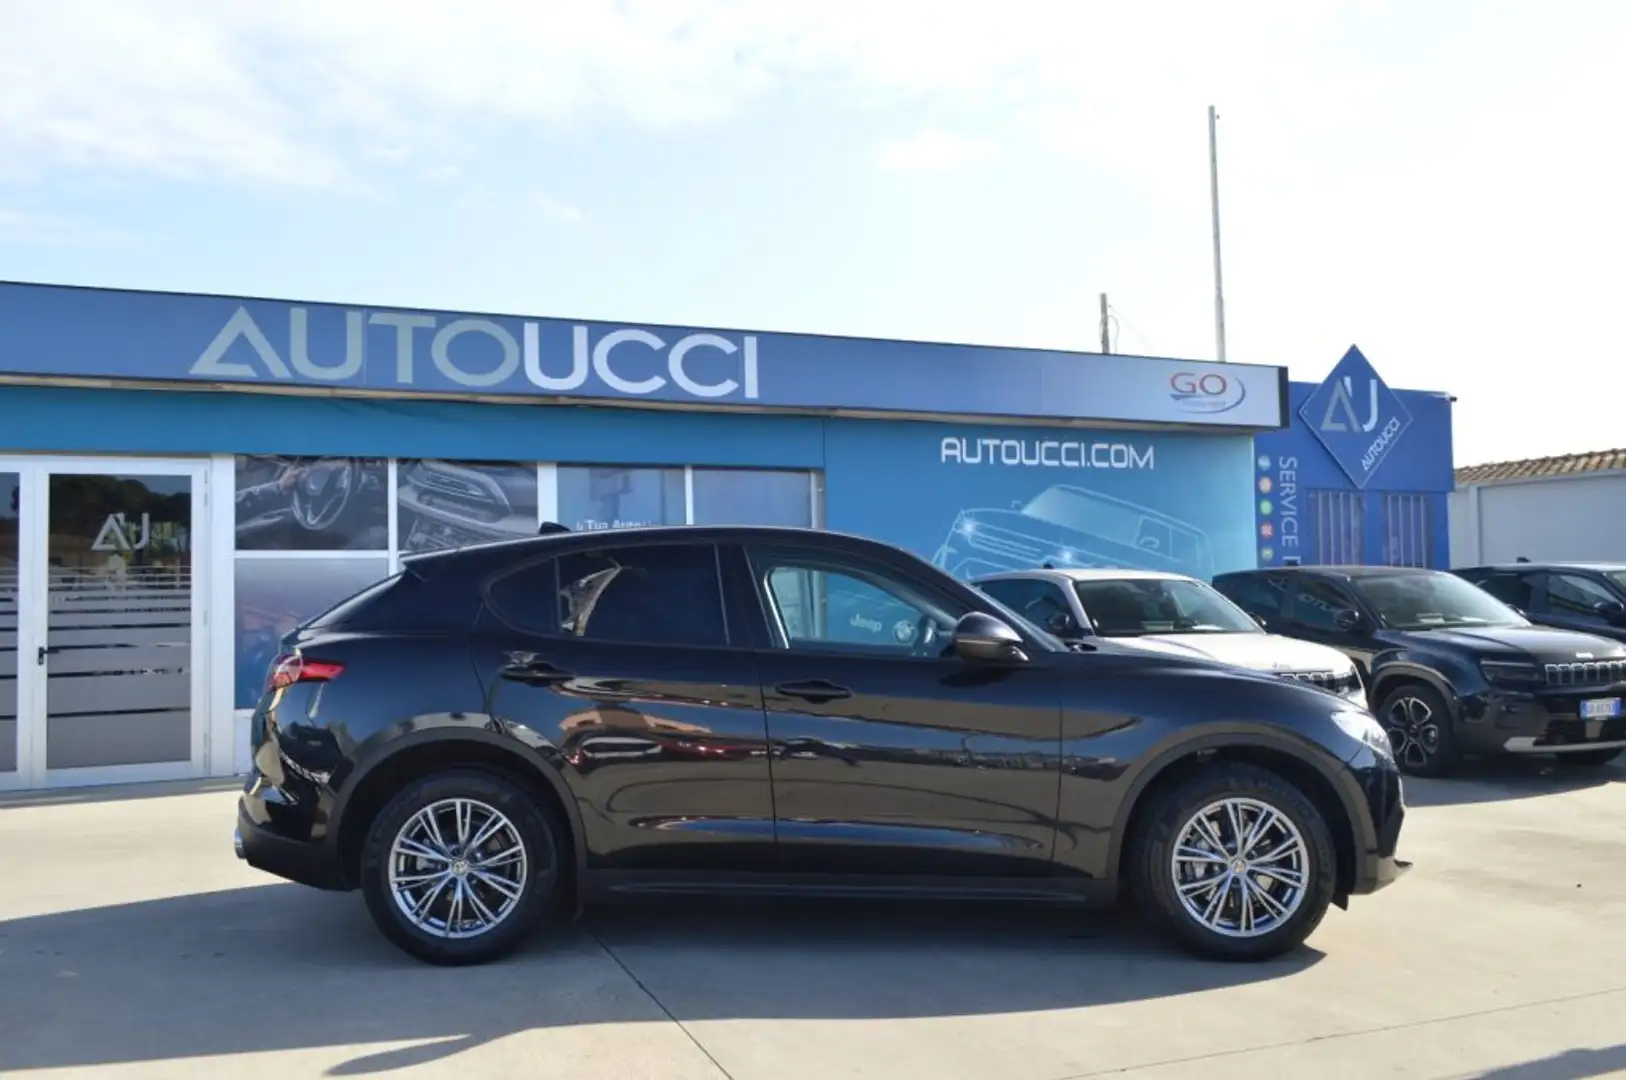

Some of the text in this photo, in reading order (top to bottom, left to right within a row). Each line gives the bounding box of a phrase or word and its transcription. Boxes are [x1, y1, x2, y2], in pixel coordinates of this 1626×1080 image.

[188, 305, 758, 398] AUTOUCCI
[1170, 371, 1227, 396] GO
[940, 436, 1155, 470] AUTOUCCI.COM
[1360, 416, 1400, 471] AUTOUCCI
[1278, 456, 1299, 547] SERVICE
